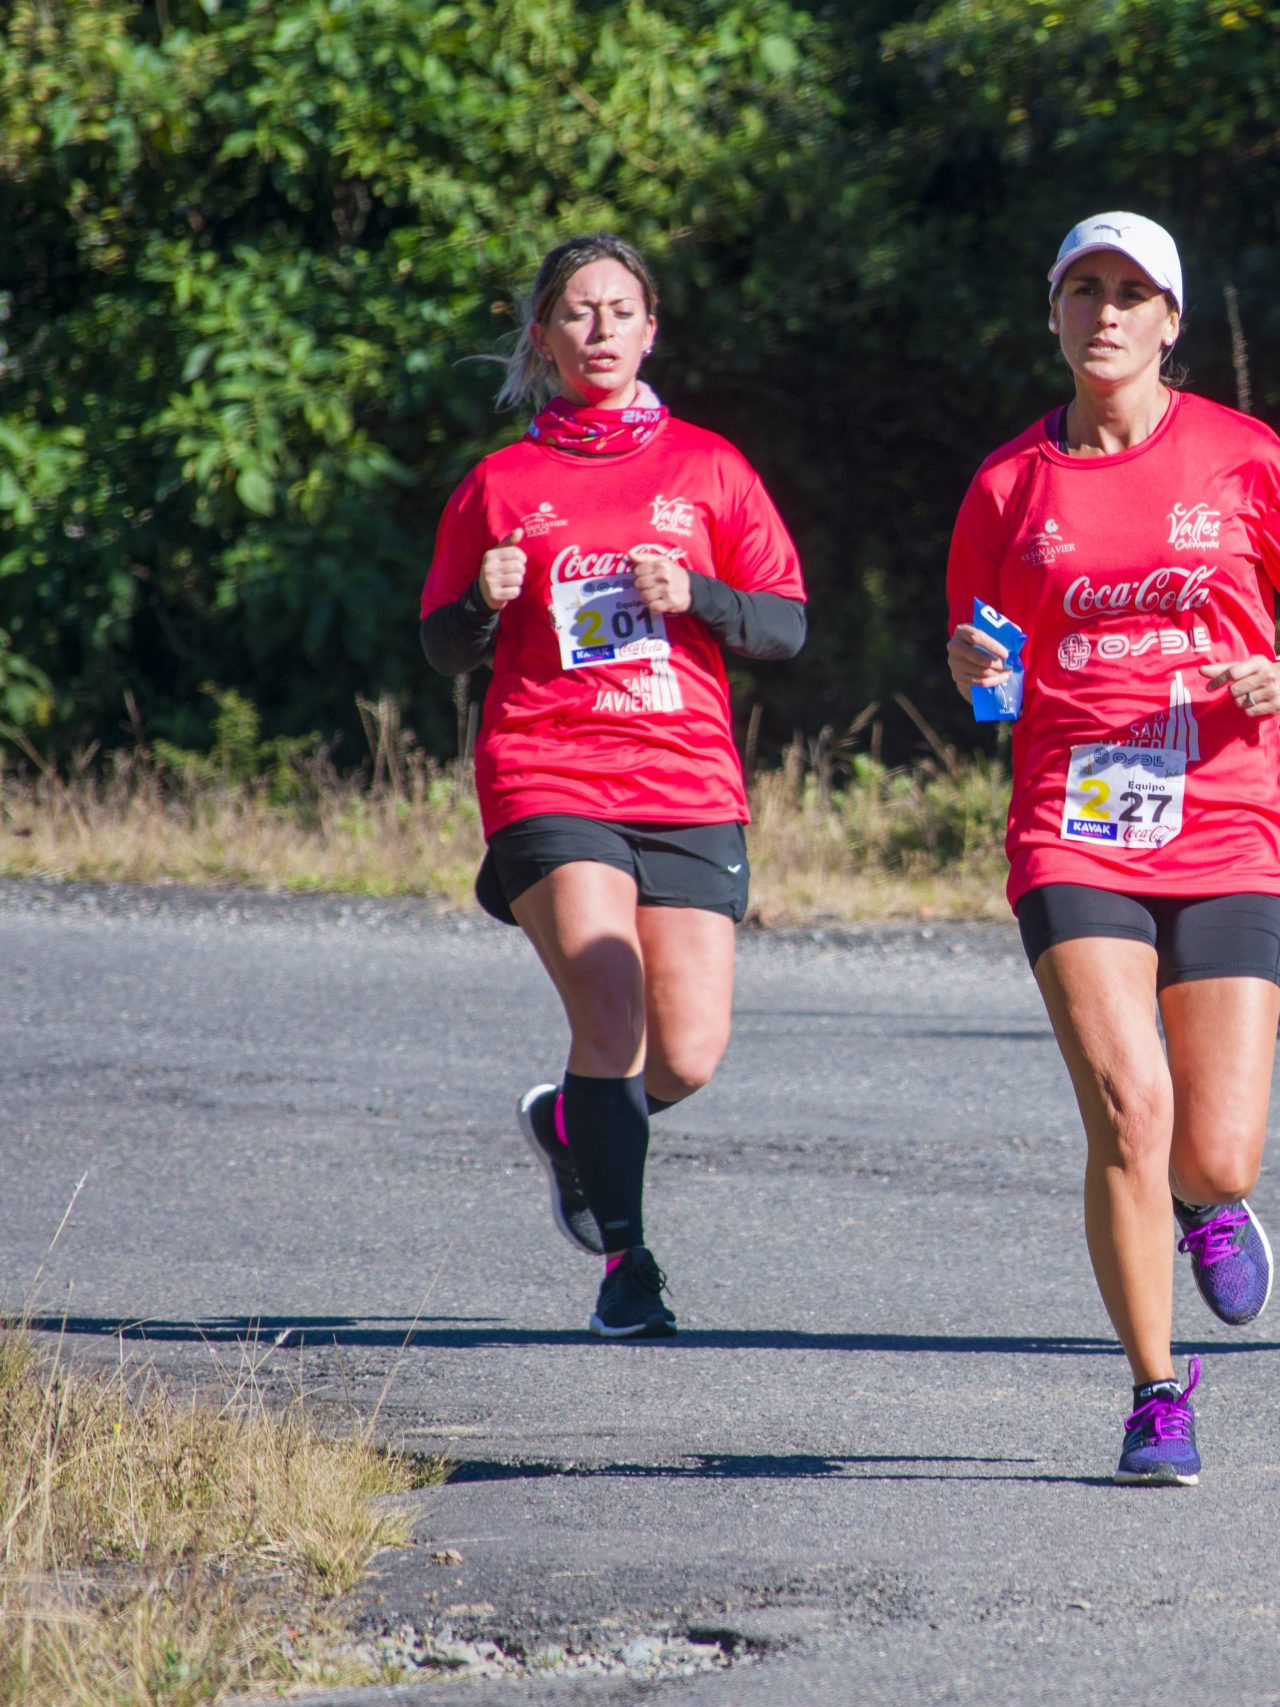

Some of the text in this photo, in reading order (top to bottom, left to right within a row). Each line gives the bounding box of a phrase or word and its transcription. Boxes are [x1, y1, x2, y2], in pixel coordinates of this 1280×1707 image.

[1166, 503, 1221, 545] Valles
[1046, 543, 1075, 555] JAVIER
[1063, 565, 1218, 619] Coca-Cola
[576, 607, 654, 647] 2 01
[1098, 627, 1212, 659] OSDE
[622, 676, 651, 692] SAN
[591, 691, 653, 712] JAVIER
[1130, 723, 1164, 739] SAN
[1112, 752, 1165, 768] OSDE
[1128, 781, 1165, 792] Equipo
[1078, 778, 1173, 823] 2 27
[1073, 820, 1111, 836] KAVAK
